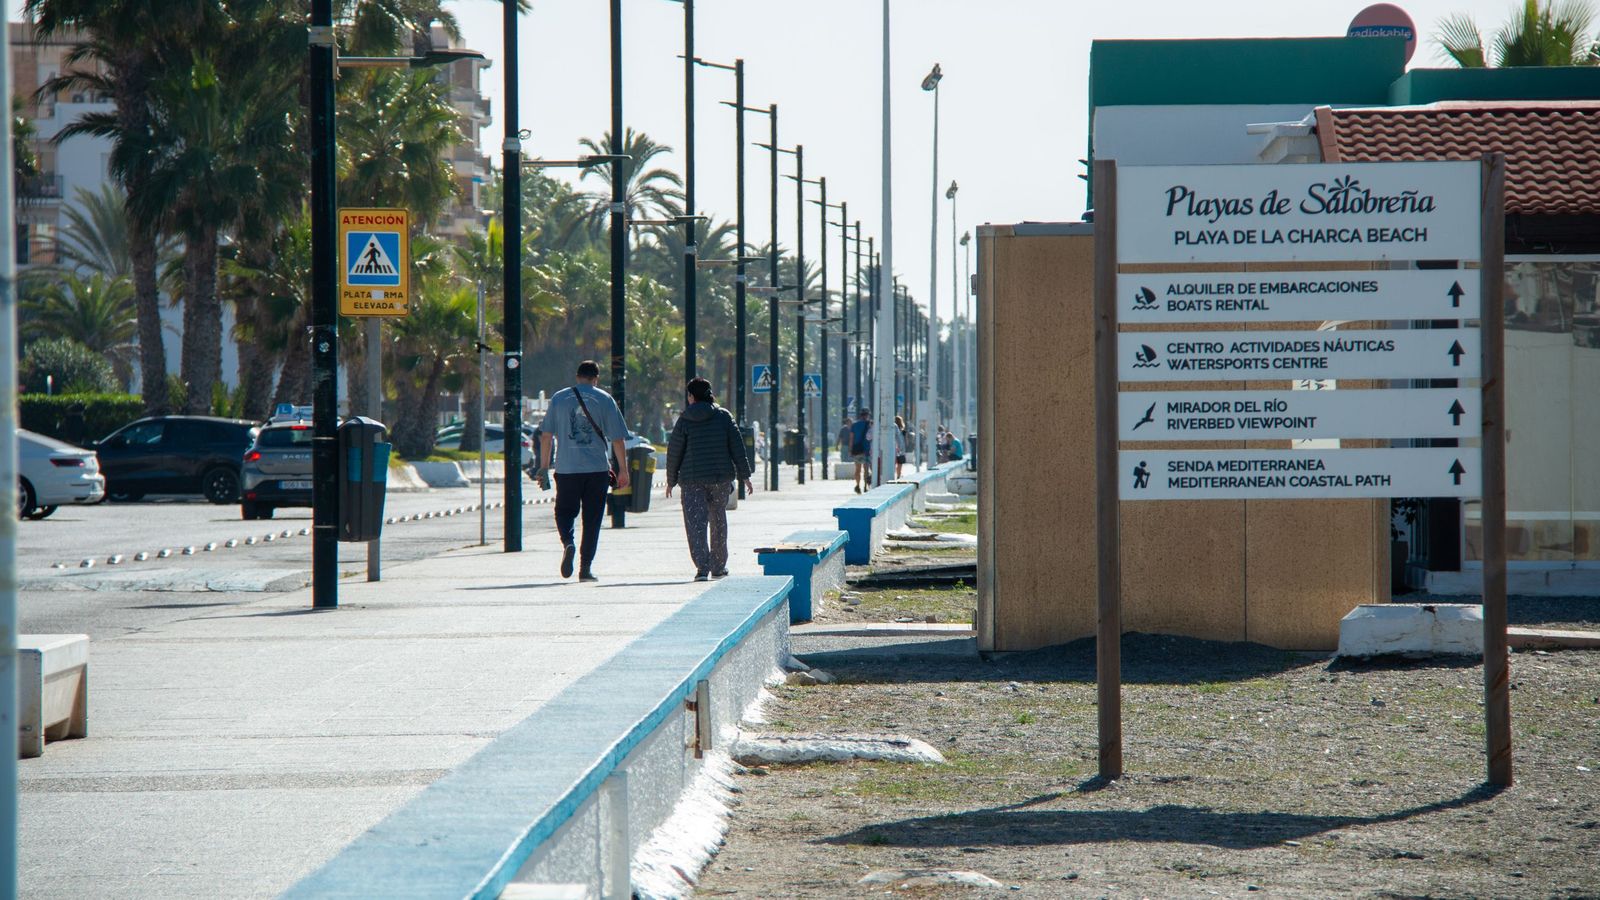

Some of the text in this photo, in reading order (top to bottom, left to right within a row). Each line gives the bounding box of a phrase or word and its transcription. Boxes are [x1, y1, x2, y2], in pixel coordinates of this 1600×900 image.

[1165, 181, 1436, 224] Playas de Salobreña
[343, 214, 404, 225] ATENCIÓN
[1174, 227, 1428, 246] PLAYA DE LA CHARCA BEACH
[343, 291, 404, 299] PLATARMA
[1167, 281, 1378, 296] ALQUILER DE EMBARCACIONES
[353, 302, 395, 310] ELEVADA
[1167, 298, 1269, 312] BOATS RENTAL
[1166, 338, 1395, 354] CENTRO ACTIVIDADES NÁUTICAS
[1166, 356, 1328, 371] WATERSPORTS CENTRE
[281, 406, 289, 414] L
[1166, 398, 1288, 414] MIRADOR DEL RÍO
[1167, 416, 1318, 430] RIVERBED VIEWPOINT
[1167, 459, 1326, 473] SENDA MEDITERRANEA
[1168, 474, 1391, 489] MEDITERRANEAN COASTAL PATH
